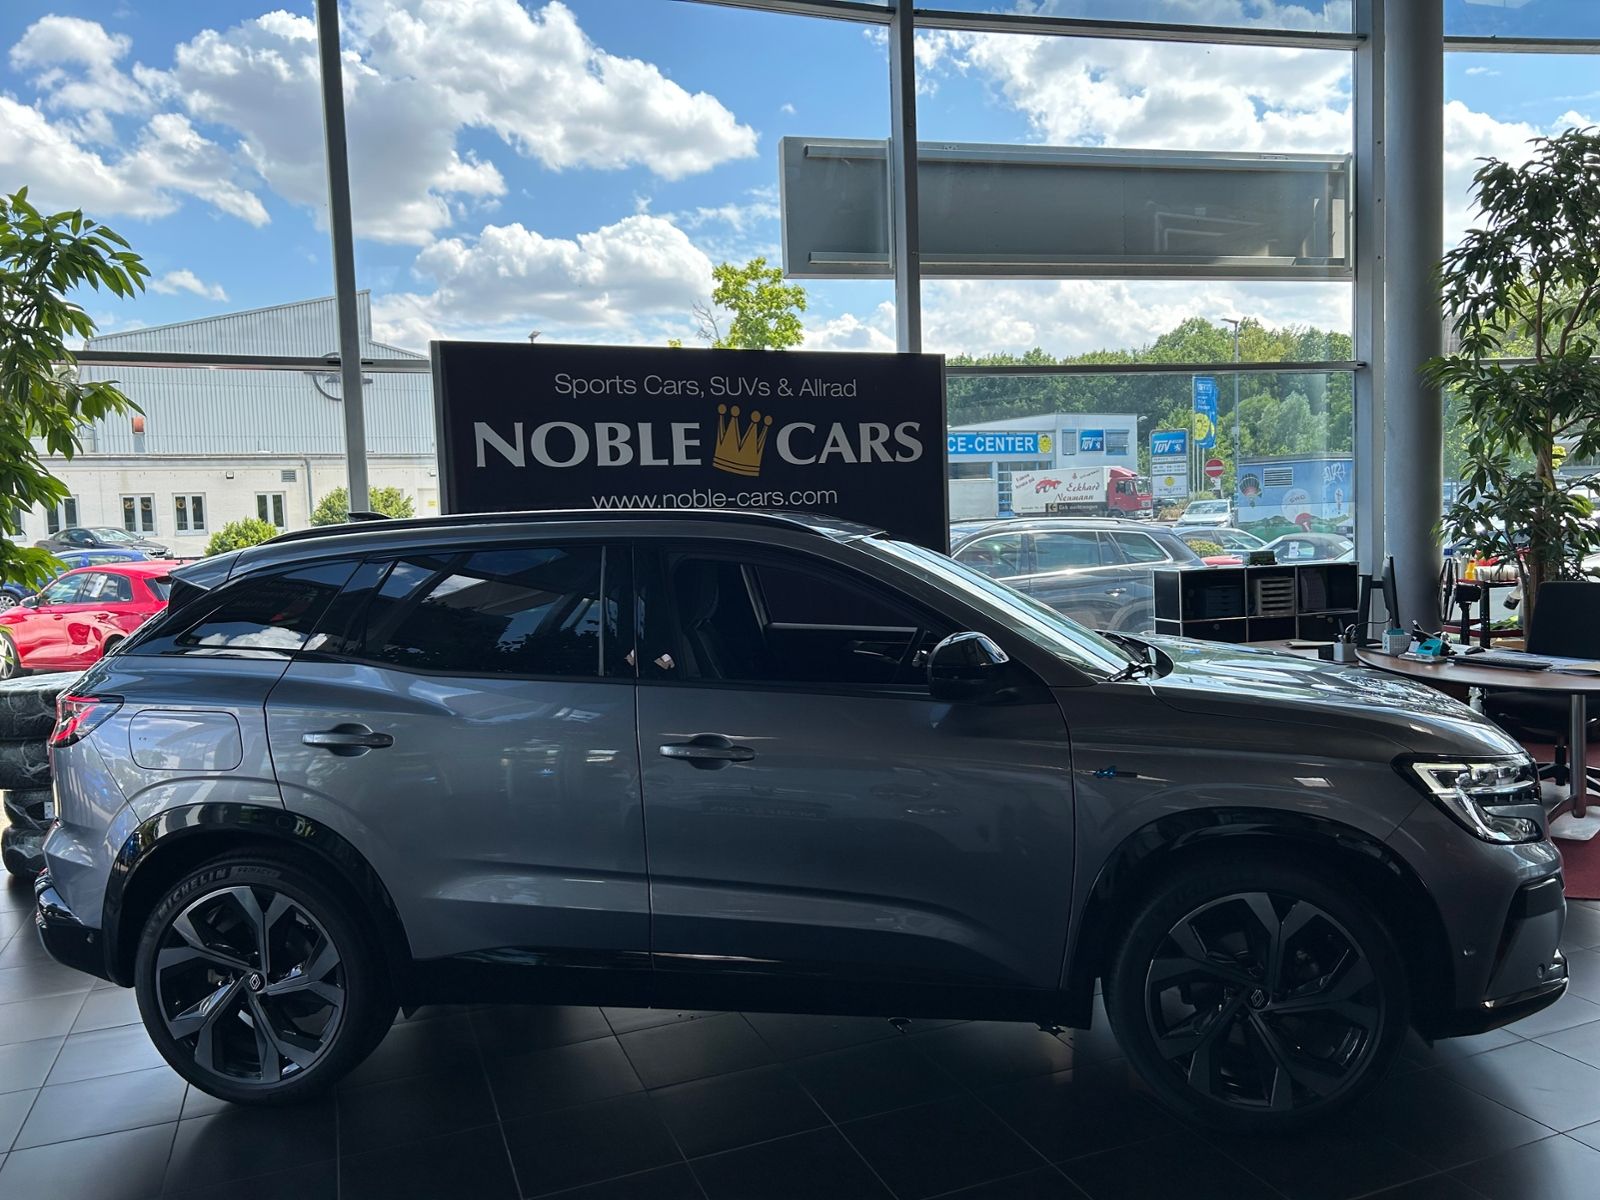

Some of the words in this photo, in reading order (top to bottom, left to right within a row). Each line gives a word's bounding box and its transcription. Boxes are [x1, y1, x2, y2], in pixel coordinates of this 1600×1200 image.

[554, 373, 638, 399] Sports
[643, 375, 706, 399] Cars,
[710, 376, 771, 397] SUVs
[777, 378, 794, 397] &
[799, 379, 857, 398] Allrad
[473, 421, 702, 468] NOBLE
[776, 421, 924, 465] CARS
[592, 487, 839, 510] www.noble-cars.com
[1054, 492, 1094, 503] Neumann
[1066, 481, 1101, 492] Eckhard
[158, 867, 227, 918] MICHELIN
